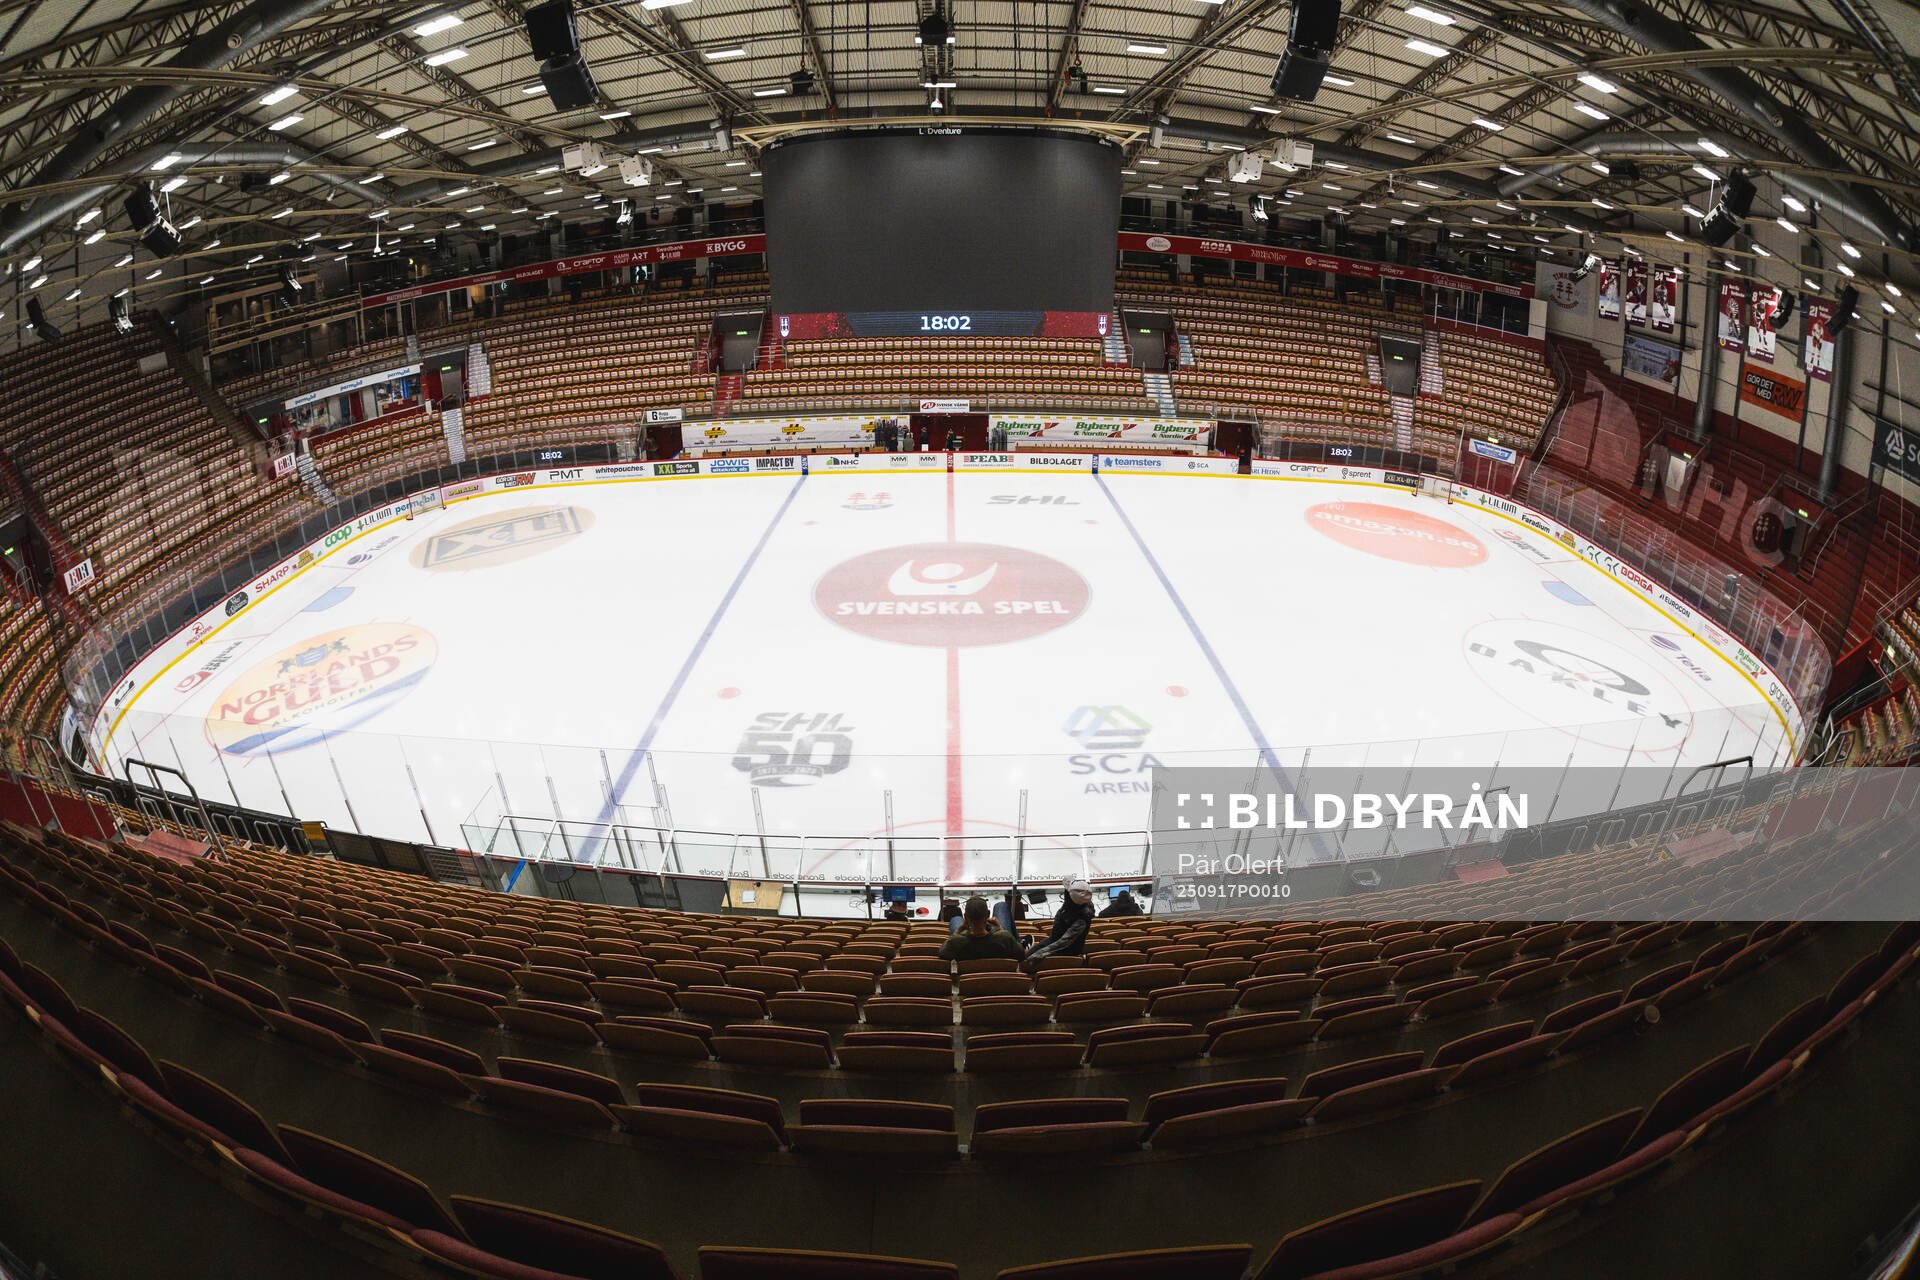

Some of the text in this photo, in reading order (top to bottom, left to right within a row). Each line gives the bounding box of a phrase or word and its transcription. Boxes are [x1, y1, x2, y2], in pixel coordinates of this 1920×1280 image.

[920, 316, 971, 331] 18:02
[1075, 421, 1120, 433] Byberg
[1153, 423, 1196, 435] Byberg
[540, 451, 562, 460] 18:02
[969, 455, 1008, 463] PEAB
[1330, 448, 1352, 457] 18:02
[657, 464, 675, 474] XXL
[710, 459, 749, 467] JOWIC
[756, 457, 782, 468] IMPACT
[783, 457, 794, 467] BY
[1030, 457, 1082, 466] BILBOLAGET
[1114, 458, 1162, 467] teamsters
[549, 469, 583, 480] PMT
[1488, 497, 1517, 515] LILIUM
[364, 507, 392, 526] LILIUM
[1521, 514, 1550, 534] Faradium
[324, 525, 352, 548] coop
[1314, 511, 1479, 551] amazon.se
[255, 565, 290, 593] SHARP
[836, 600, 1069, 615] SVENSKA SPEL
[1664, 596, 1691, 618] EUROCON
[1676, 654, 1712, 682] Telia
[220, 634, 419, 721] NORRLANDS
[243, 655, 400, 726] GULD
[746, 712, 856, 732] SHL
[731, 732, 853, 775] 50
[1068, 753, 1164, 775] SCA
[1084, 780, 1168, 794] ARENA
